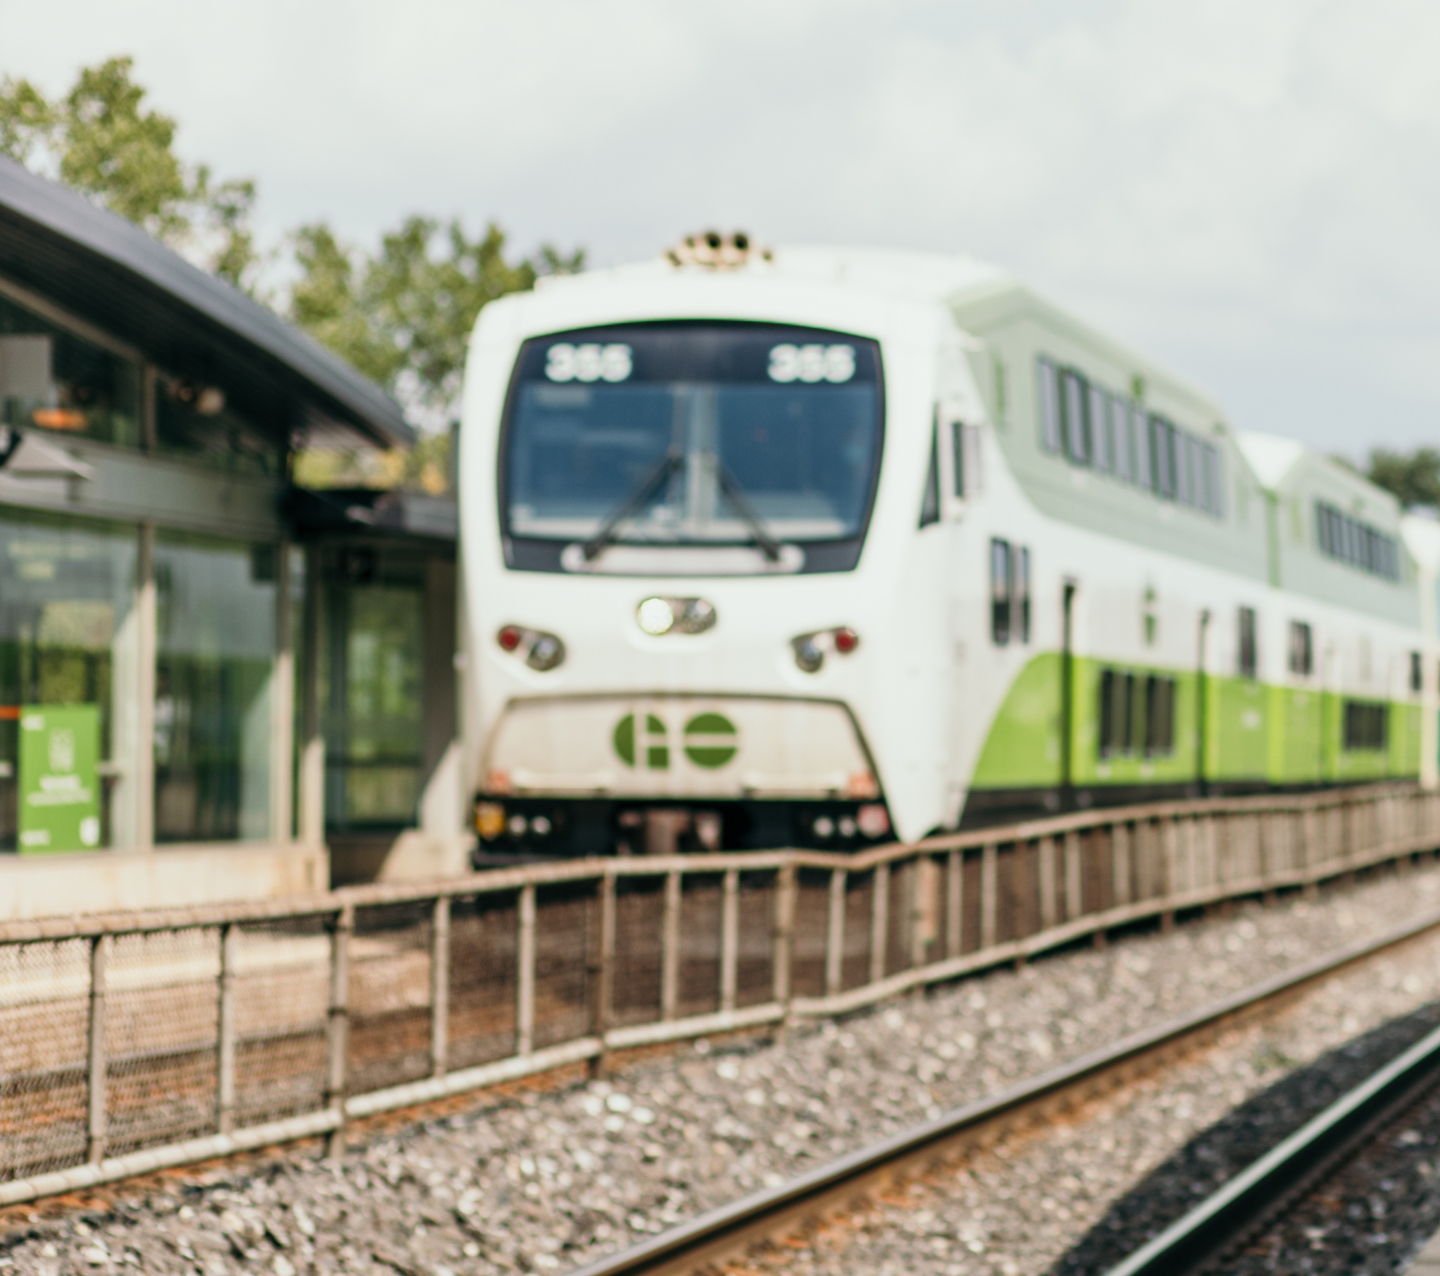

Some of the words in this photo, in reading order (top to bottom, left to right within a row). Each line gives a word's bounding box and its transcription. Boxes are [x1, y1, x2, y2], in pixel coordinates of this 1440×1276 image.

[545, 343, 633, 383] 355
[767, 343, 856, 384] 355
[613, 712, 738, 770] GO
